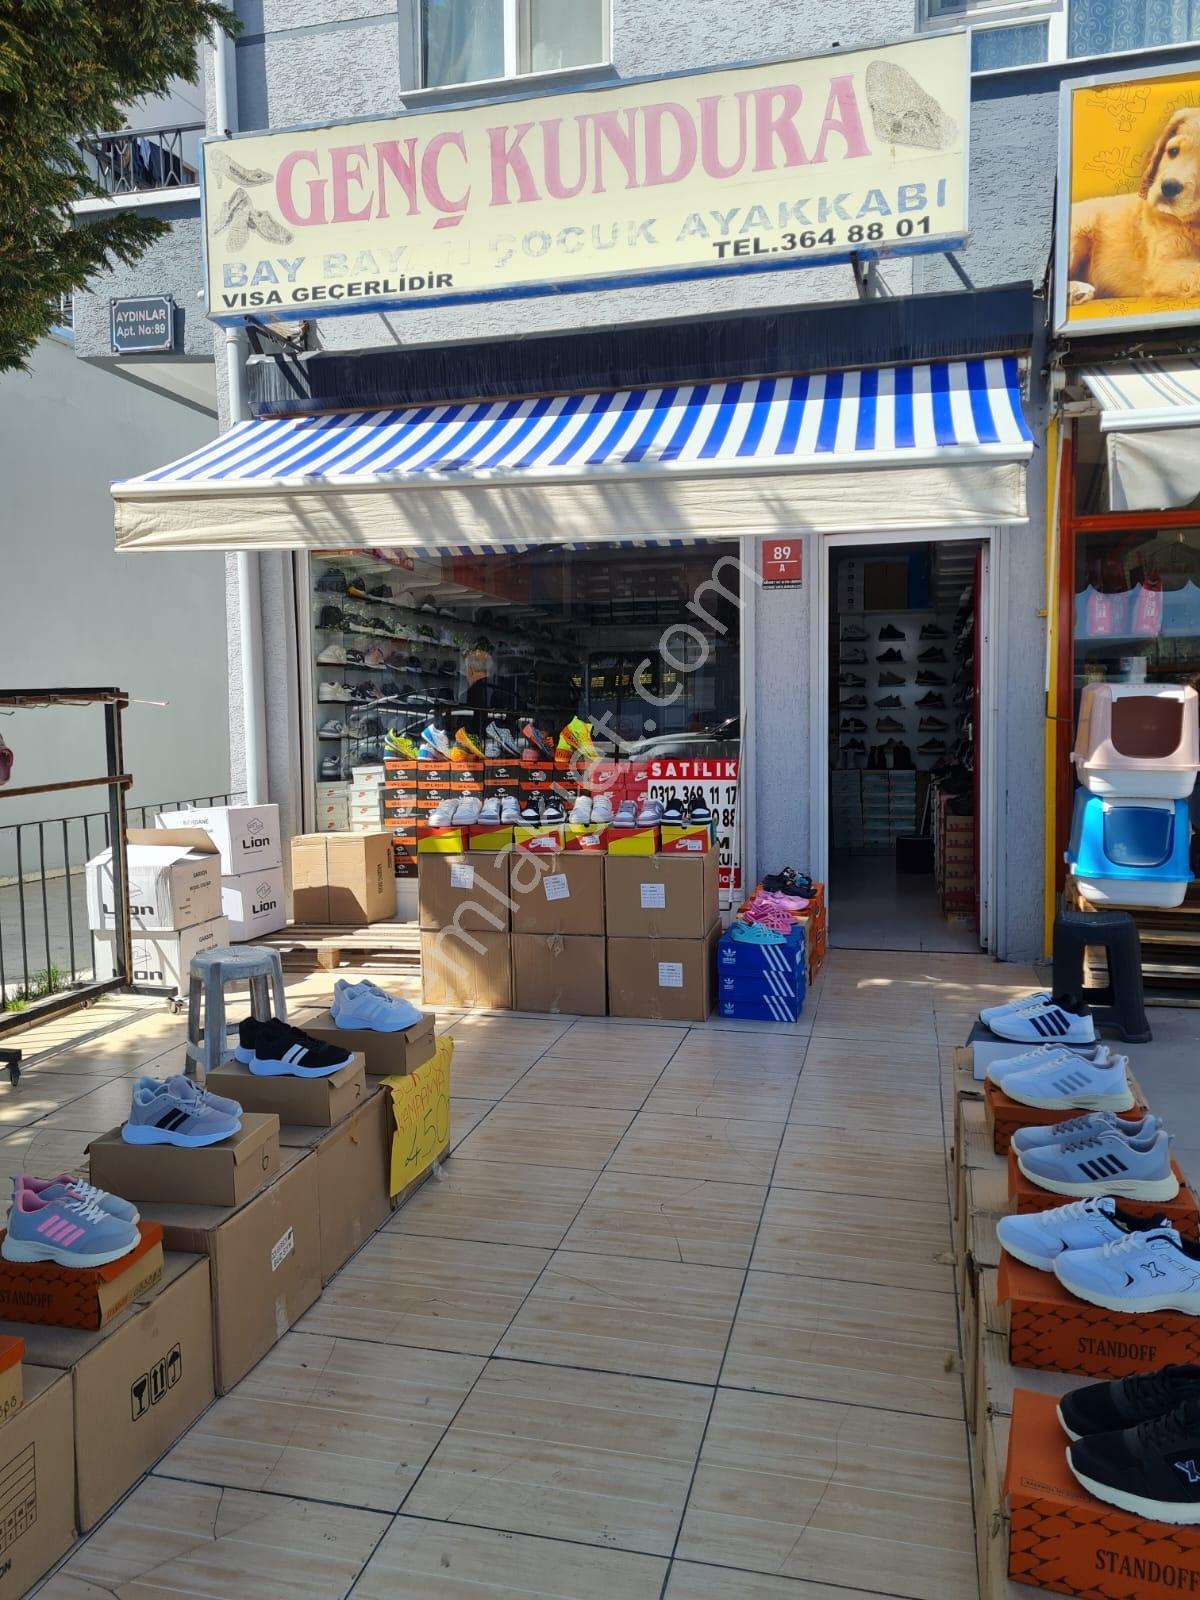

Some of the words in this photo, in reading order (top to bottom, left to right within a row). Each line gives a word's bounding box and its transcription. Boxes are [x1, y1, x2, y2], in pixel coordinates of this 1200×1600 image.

[276, 130, 471, 230] GENÇ
[486, 74, 873, 207] KUNDURA
[222, 256, 306, 289] BAY
[675, 178, 946, 242] AYAKKABI
[712, 227, 836, 259] TEL.364
[847, 222, 884, 244] 88
[895, 216, 932, 238] 01
[222, 290, 284, 309] VISA
[291, 271, 455, 303] GEÇERLİDİR
[116, 309, 167, 323] AYDINLAR
[116, 326, 136, 339] Apt.
[138, 323, 166, 336] No:89
[773, 546, 791, 560] 89
[779, 563, 786, 573] A
[651, 762, 737, 777] SATILIK
[650, 785, 677, 804] 0312
[709, 785, 720, 805] 11
[725, 785, 737, 805] 17
[242, 836, 270, 849] Lion
[102, 903, 154, 916] Lon
[252, 899, 277, 914] Lion
[1077, 1336, 1158, 1362] STANDOFF
[1094, 1548, 1200, 1593] STANDOFF
